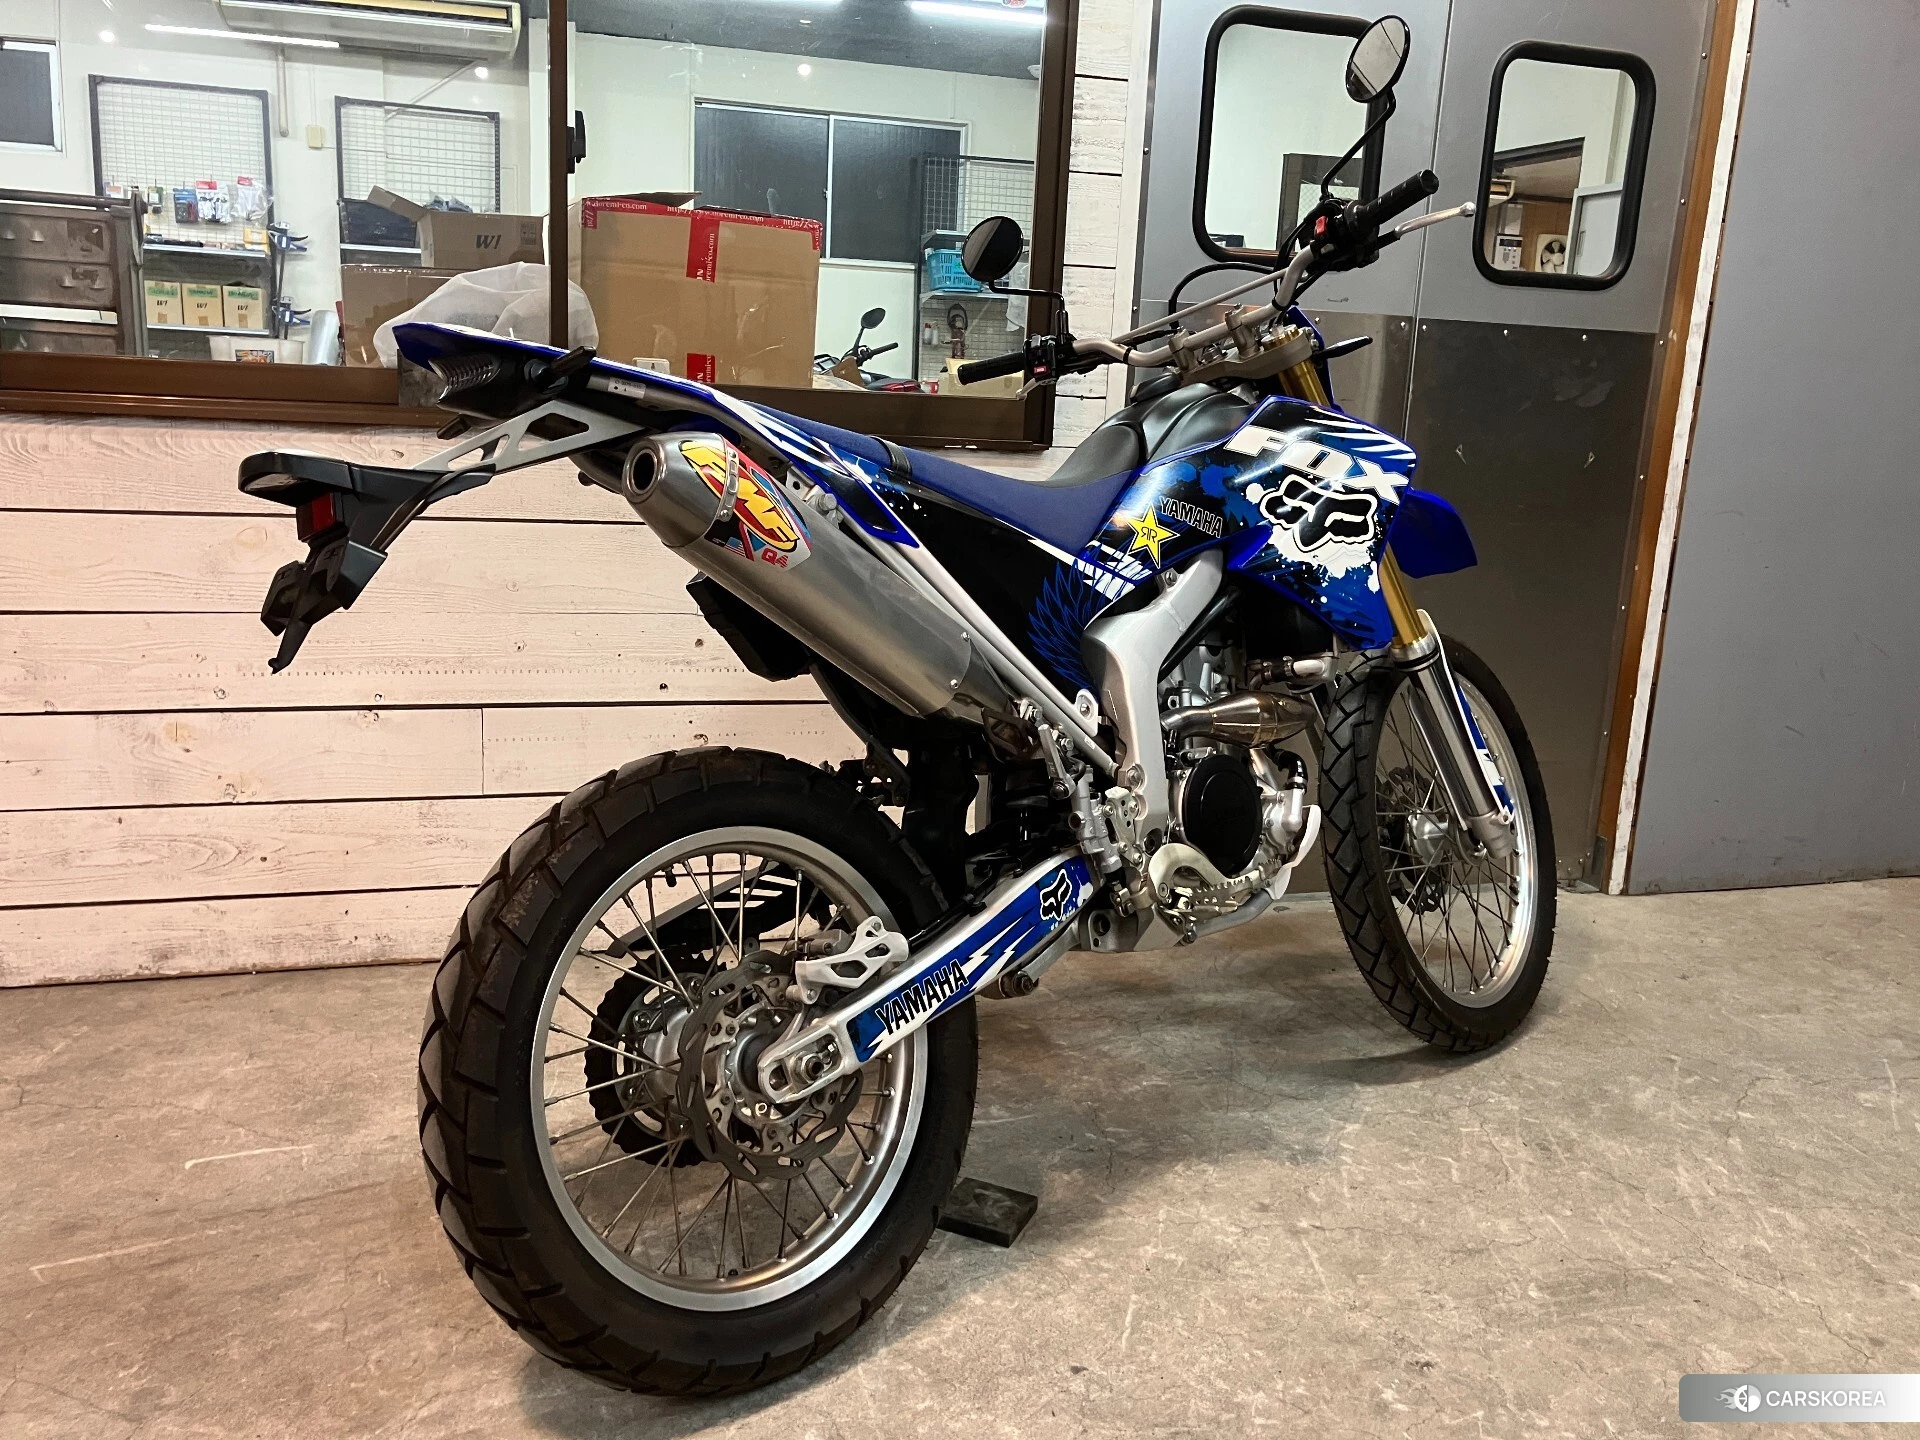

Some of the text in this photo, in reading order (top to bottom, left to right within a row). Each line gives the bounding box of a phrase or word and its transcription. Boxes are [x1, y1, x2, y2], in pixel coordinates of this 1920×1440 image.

[681, 446, 800, 542] FMF
[1223, 425, 1410, 505] FOX
[1159, 495, 1223, 539] YAMAHA
[761, 547, 789, 568] Q4
[875, 959, 969, 1035] YAMAHA
